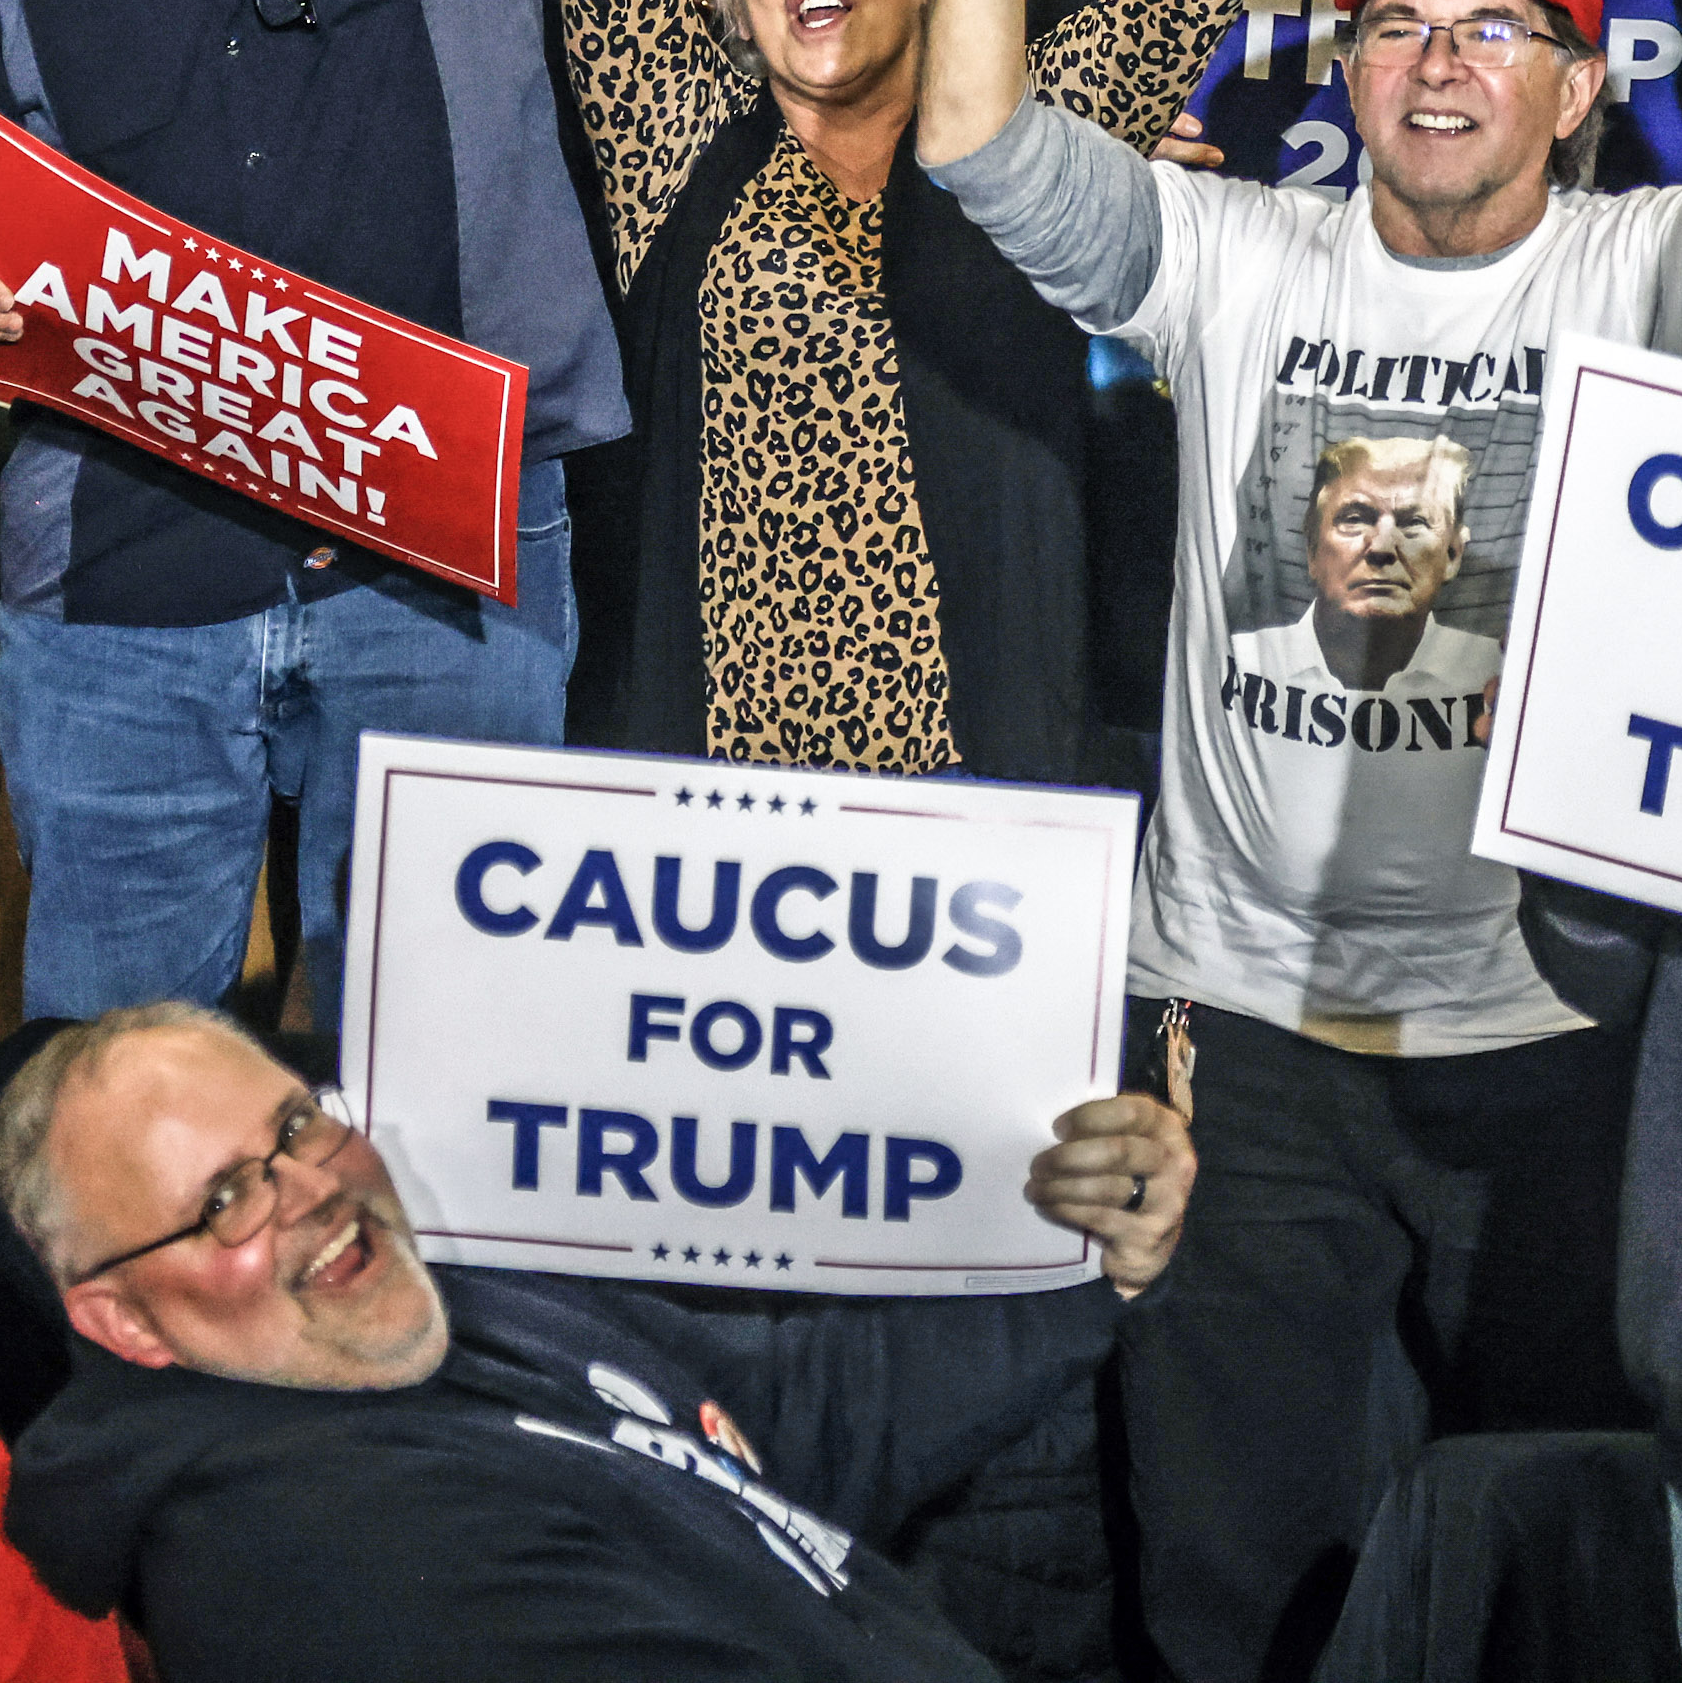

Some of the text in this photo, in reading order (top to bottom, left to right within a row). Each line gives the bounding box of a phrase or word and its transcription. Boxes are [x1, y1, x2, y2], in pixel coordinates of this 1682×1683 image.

[14, 261, 439, 460] AMERICA
[100, 227, 363, 380] MAKE
[1276, 336, 1547, 407] POLITICA
[71, 374, 387, 527] AGAIN!
[73, 337, 382, 478] GREAT
[1222, 655, 1487, 753] PRISON
[454, 840, 1025, 978] CAUCUS
[626, 993, 833, 1080] FOR
[486, 1100, 963, 1223] TRUMP
